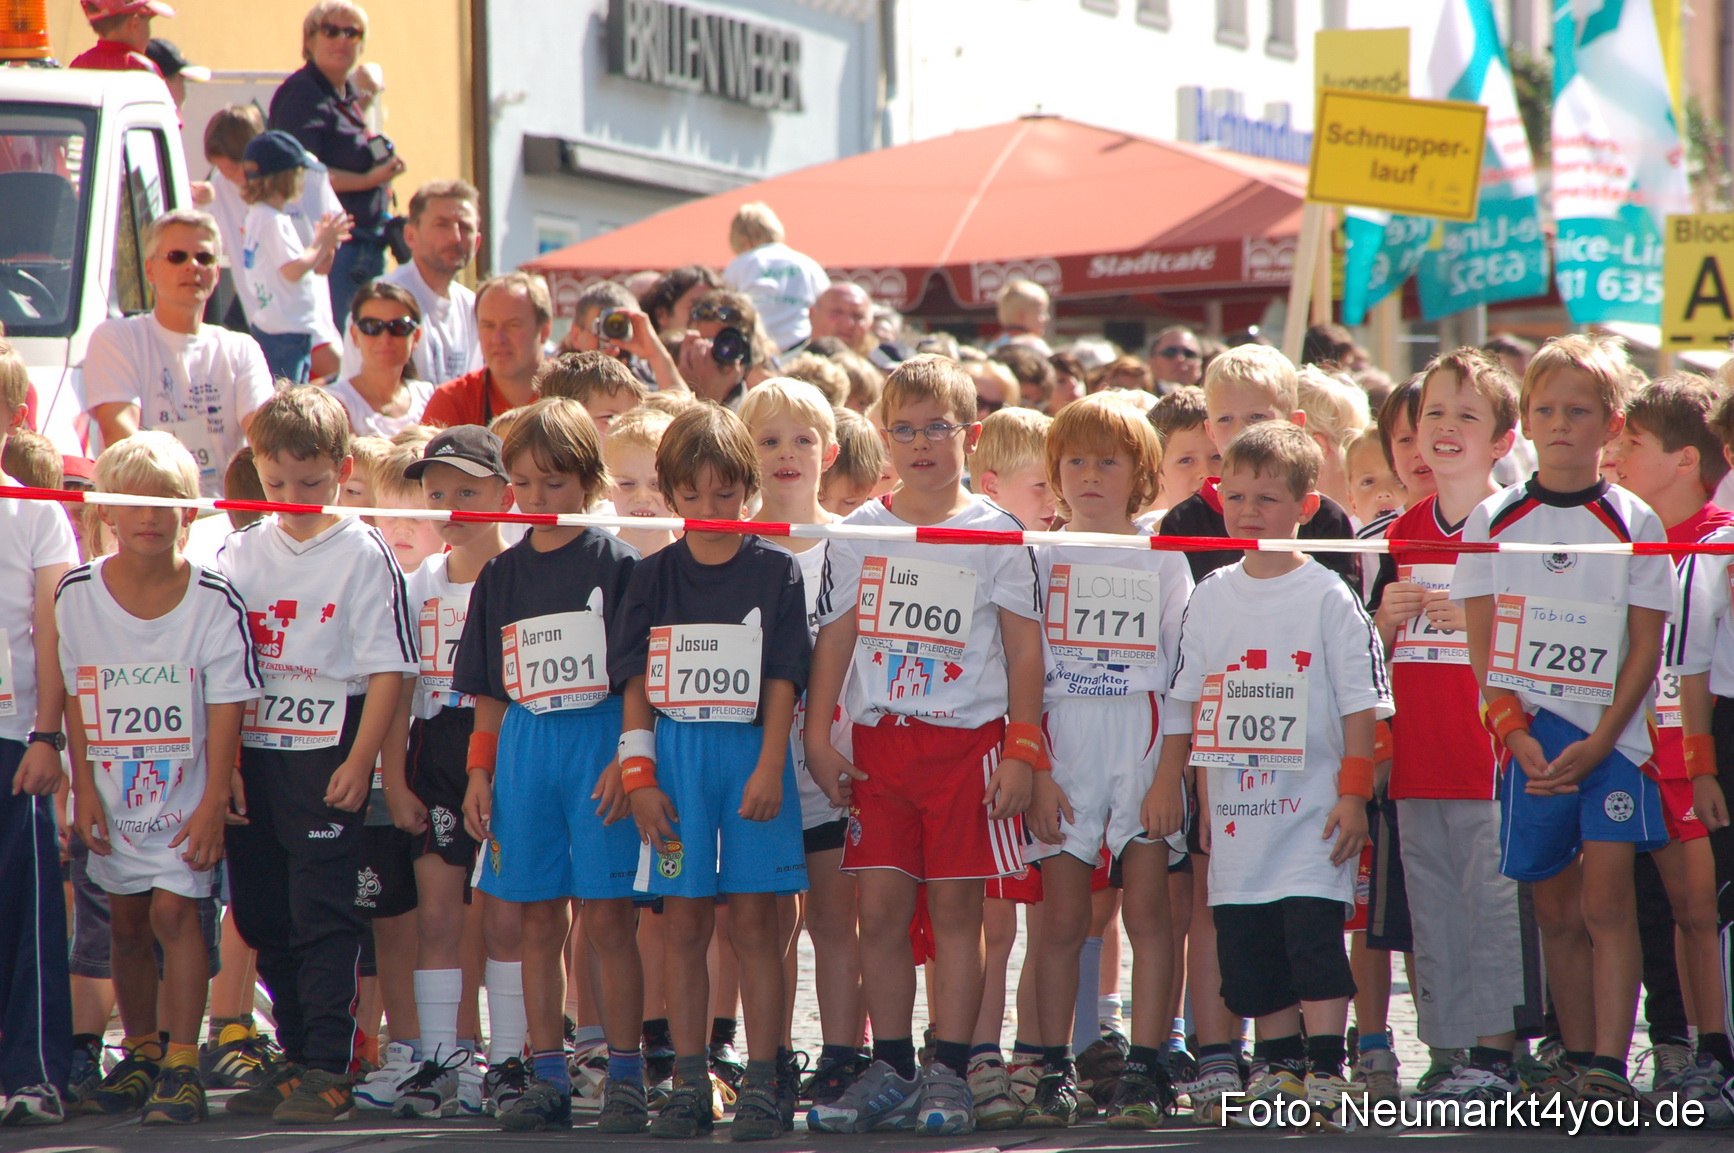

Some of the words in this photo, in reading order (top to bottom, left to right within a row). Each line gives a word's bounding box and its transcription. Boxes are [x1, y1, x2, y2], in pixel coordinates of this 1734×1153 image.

[624, 0, 720, 96] BRILLEN
[720, 17, 805, 113] WEBER
[1326, 121, 1472, 160] Schnupper-
[1370, 159, 1418, 185] lauf
[1086, 245, 1217, 279] Stadtcafé
[1682, 254, 1734, 321] A
[889, 565, 919, 586] Luis
[861, 592, 875, 606] K2
[888, 600, 962, 635] 7060
[1074, 608, 1145, 638] 7171
[1530, 607, 1588, 625] Tobias
[521, 628, 562, 648] Aaron
[675, 633, 719, 653] Josua
[444, 639, 461, 665] 7
[919, 642, 964, 656] PFLEIDERER
[1110, 649, 1157, 660] PFLEIDERER
[1439, 648, 1469, 657] PFLEIDE
[1528, 640, 1609, 675] 7287
[265, 661, 295, 671] EINZELNE
[505, 661, 516, 677] K2
[525, 653, 596, 688] 7091
[650, 663, 664, 678] K2
[100, 664, 181, 690] PASCAL
[677, 667, 751, 695] 7090
[1055, 669, 1129, 685] Neumarkter
[1489, 672, 1536, 689] BOCK
[1564, 685, 1613, 698] PFLEIDERER
[562, 691, 608, 703] PFLEIDERER
[1066, 683, 1129, 696] Stadtlauf
[1226, 679, 1295, 700] Sebastian
[264, 694, 336, 725] 7267
[711, 706, 756, 717] PFLEIDERER
[1200, 708, 1214, 722] K2
[106, 705, 183, 735] 7206
[1226, 714, 1297, 743] 7087
[145, 743, 191, 755] PFLEIDERER
[293, 735, 336, 745] PFLEIDERER
[1191, 752, 1236, 764] BOCK
[1259, 754, 1303, 764] PFLEIDERER
[308, 829, 336, 839] JAKO
